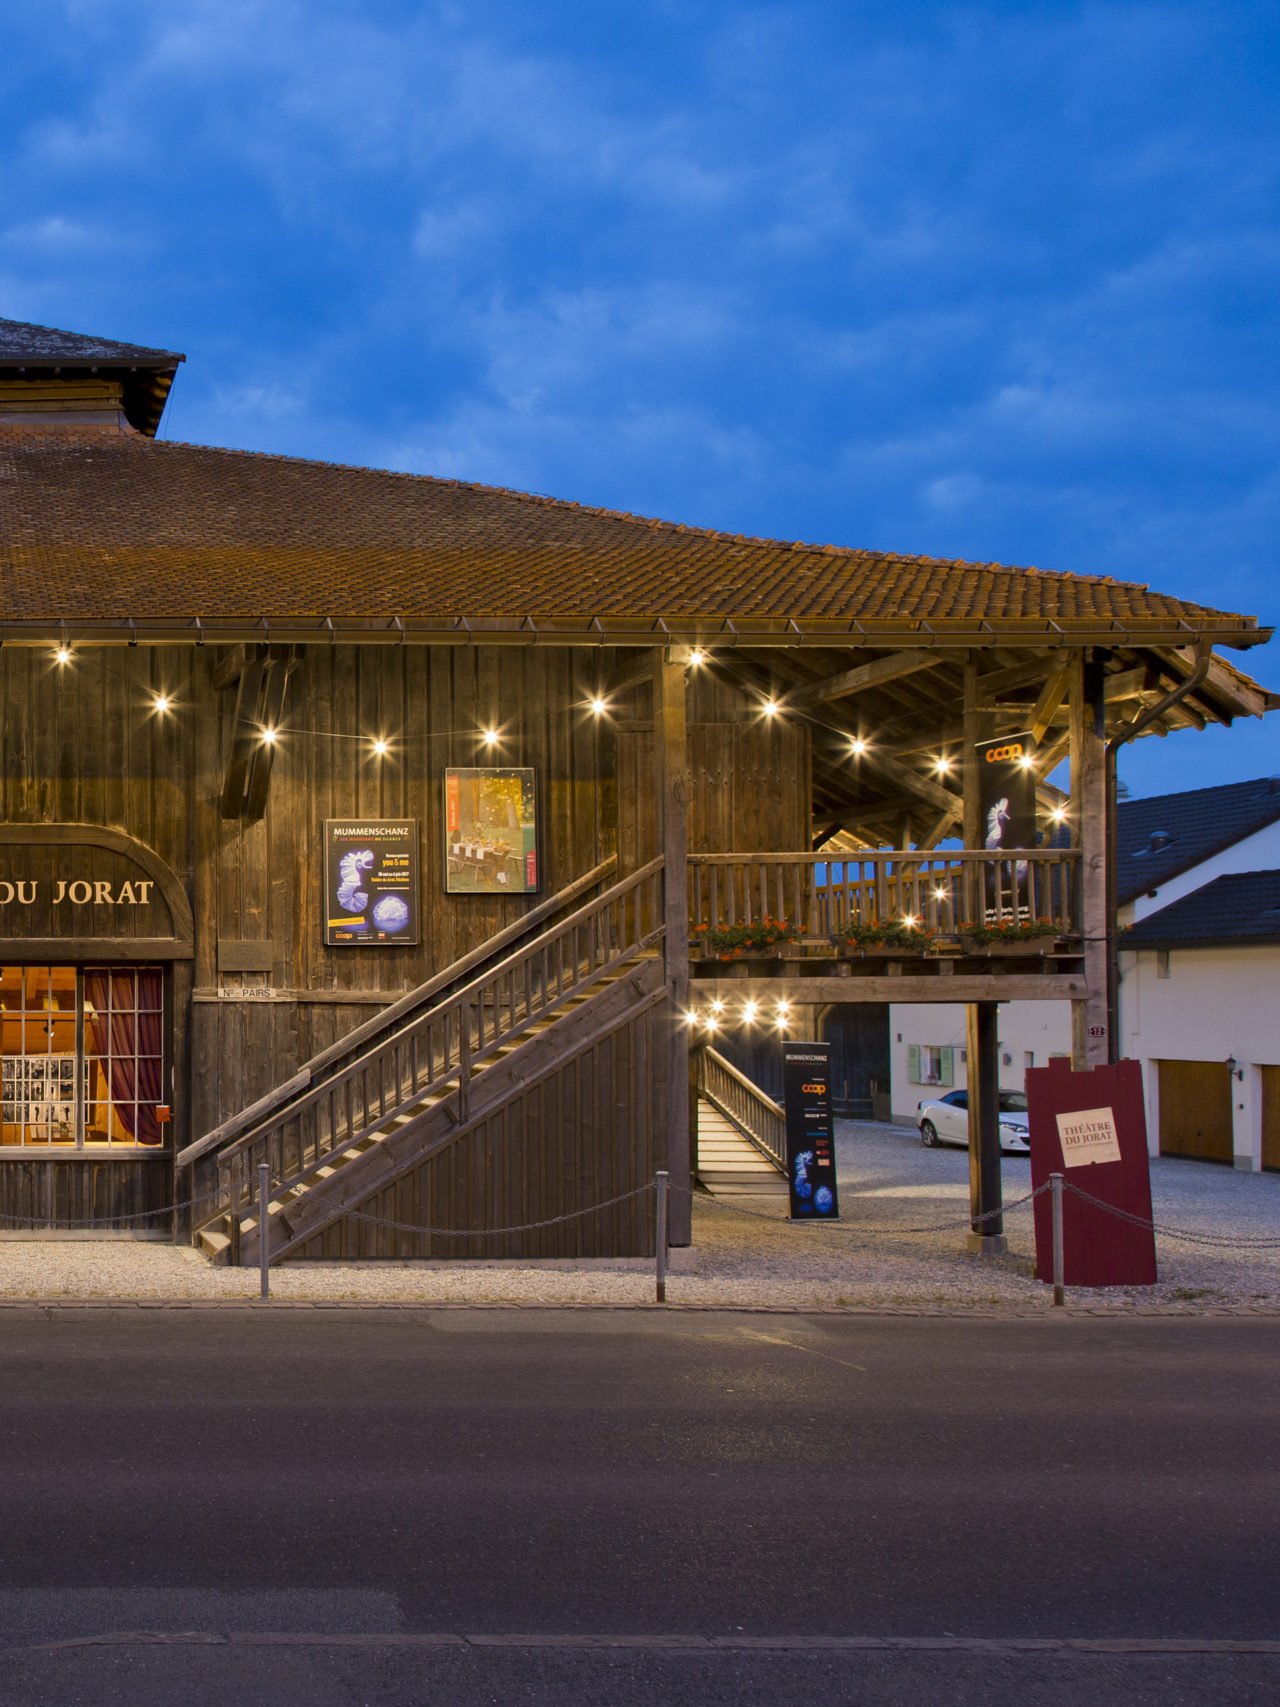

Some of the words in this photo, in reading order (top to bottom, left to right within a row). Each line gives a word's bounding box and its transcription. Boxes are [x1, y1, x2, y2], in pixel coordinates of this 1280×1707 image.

[986, 743, 1023, 762] coop
[333, 827, 409, 836] MUMMENSCHANZ
[382, 859, 394, 868] you
[52, 881, 154, 905] JORAT
[242, 988, 271, 997] PAIRS
[802, 1084, 826, 1095] coop
[1063, 1122, 1110, 1135] THÉÂTRE
[1065, 1135, 1080, 1145] DU
[1082, 1130, 1112, 1144] JORAT
